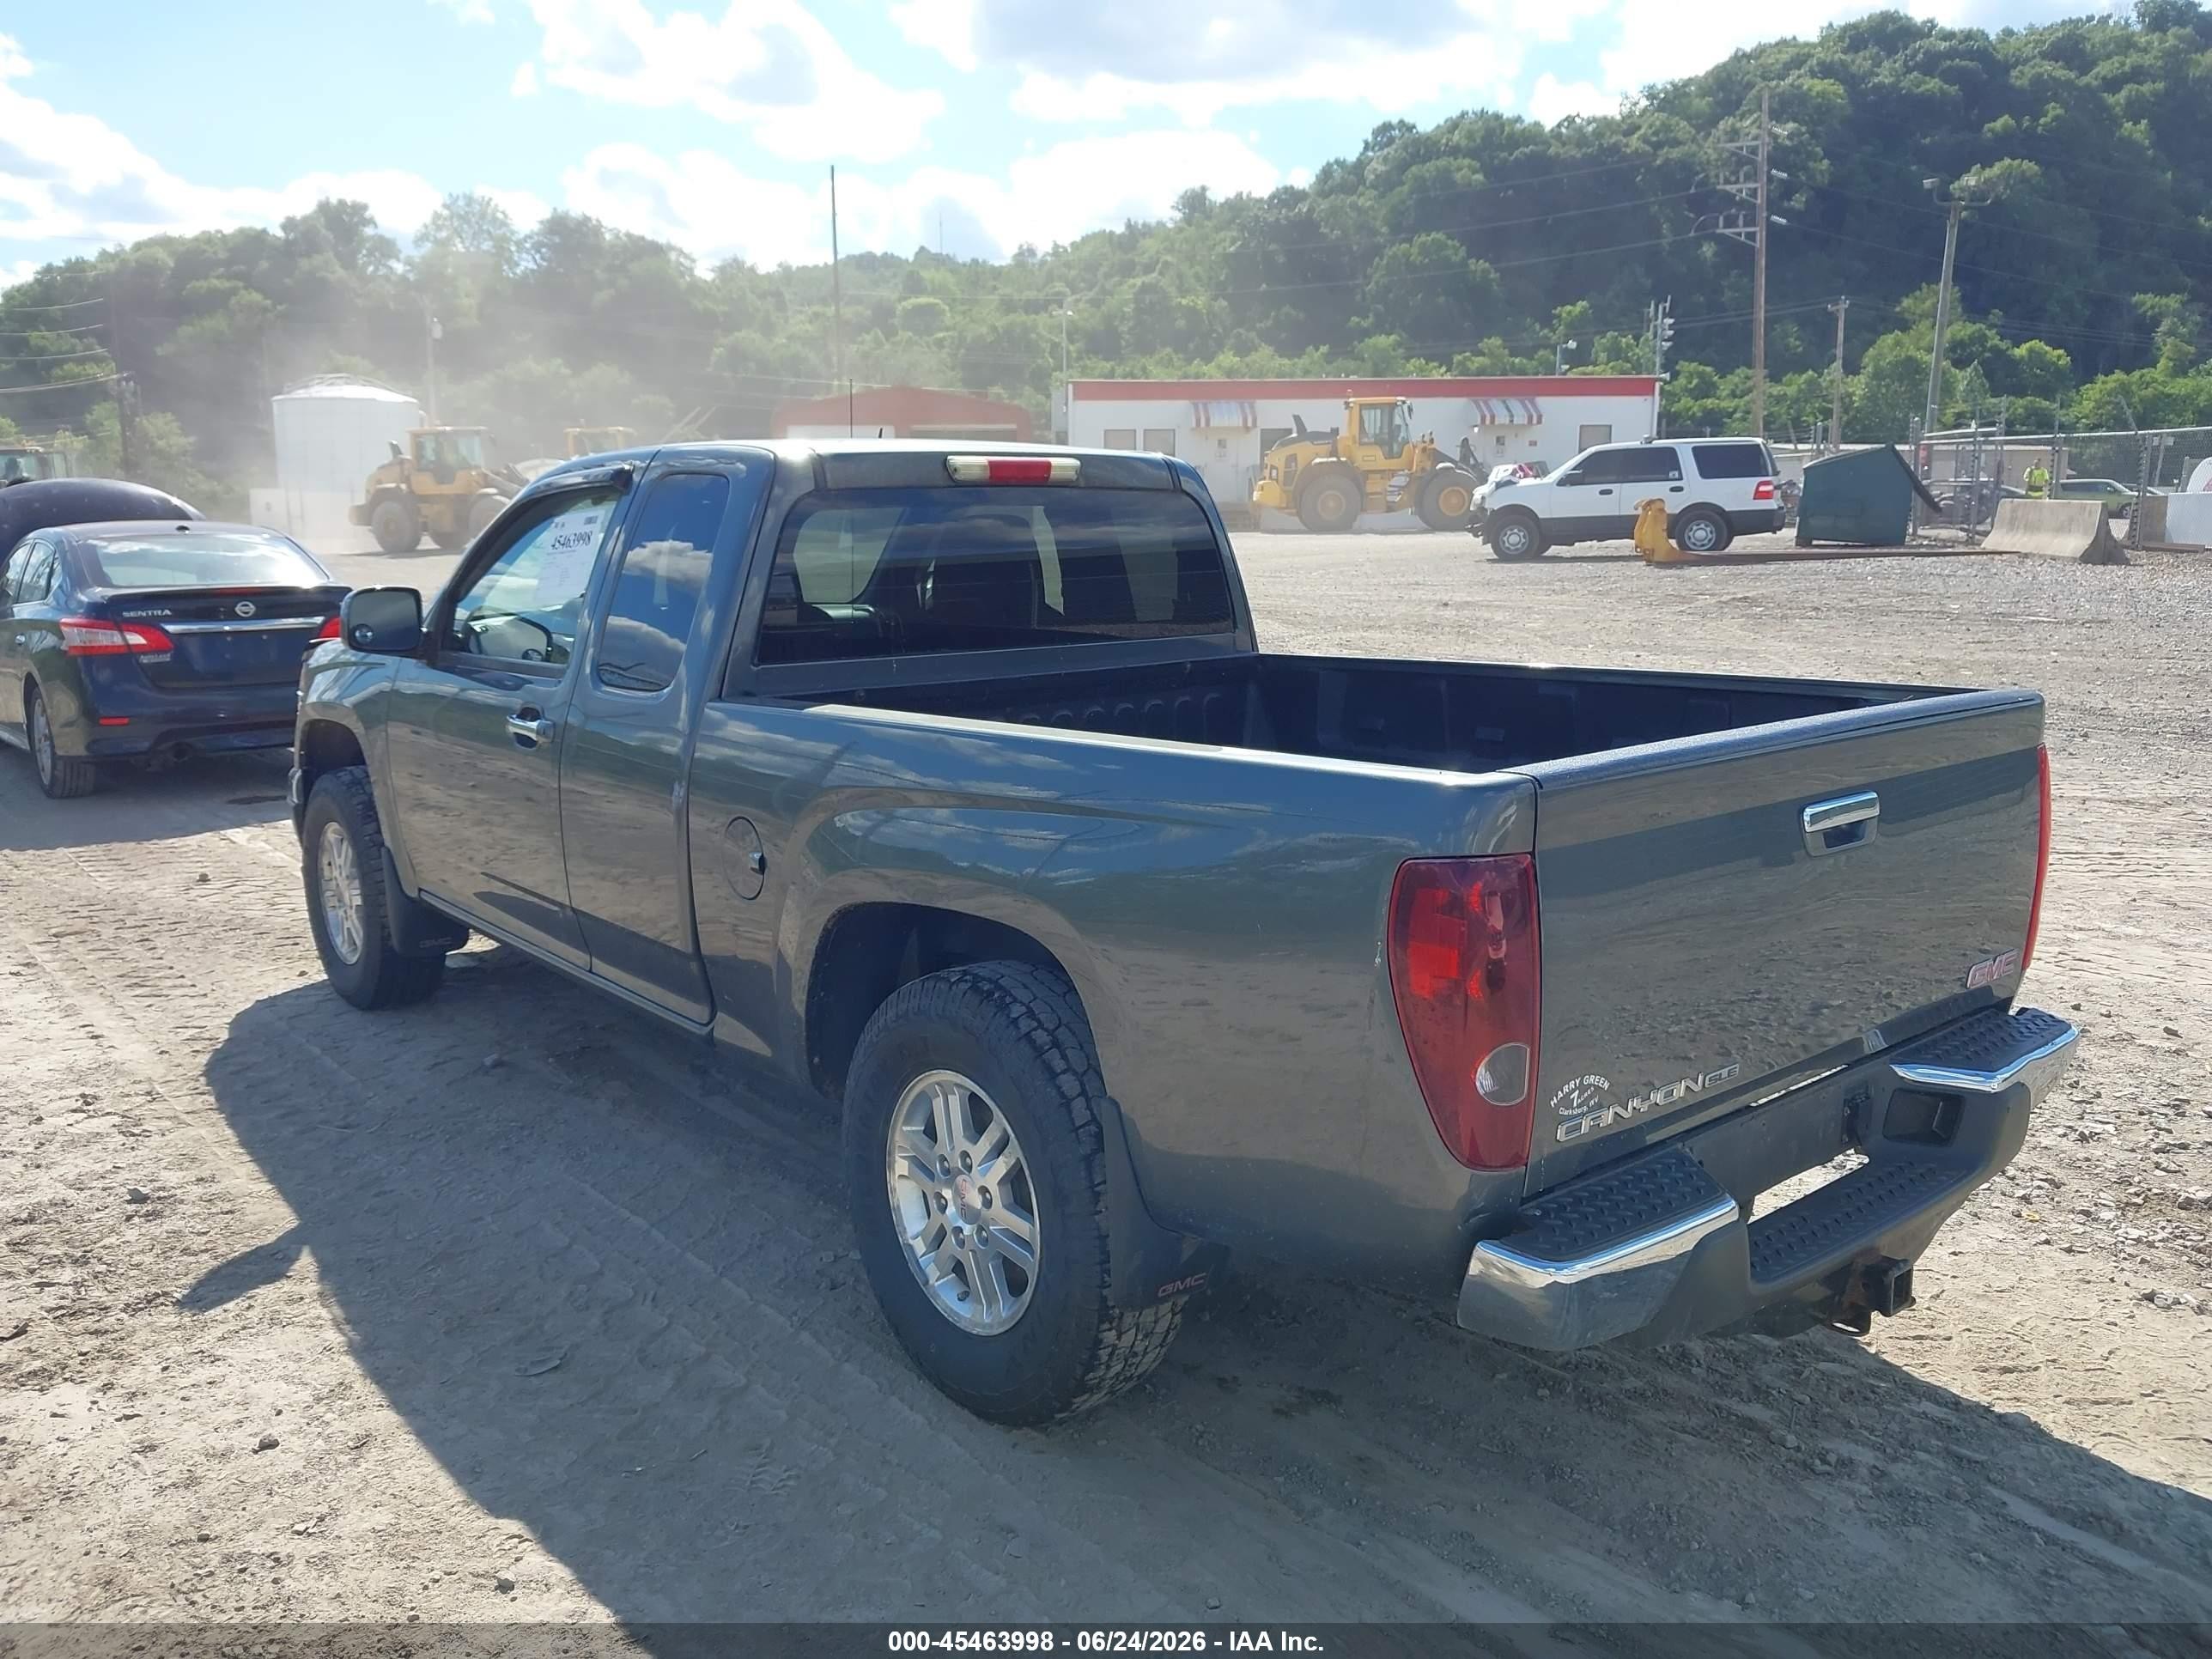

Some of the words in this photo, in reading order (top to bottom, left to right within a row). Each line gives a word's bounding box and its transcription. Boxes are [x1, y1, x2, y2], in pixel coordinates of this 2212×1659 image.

[550, 531, 592, 550] 45463998
[122, 609, 172, 618] SENTRA
[1966, 948, 2021, 989] GMC
[1550, 1077, 1582, 1108] HARRY
[1583, 1074, 1610, 1091] GREEN
[1556, 1072, 1705, 1142] CANYON
[1704, 1063, 1740, 1088] SLE
[1570, 1089, 1579, 1108] 7
[1577, 1085, 1595, 1104] ACRES
[1589, 1094, 1599, 1108] WV
[1158, 1272, 1206, 1297] GMC
